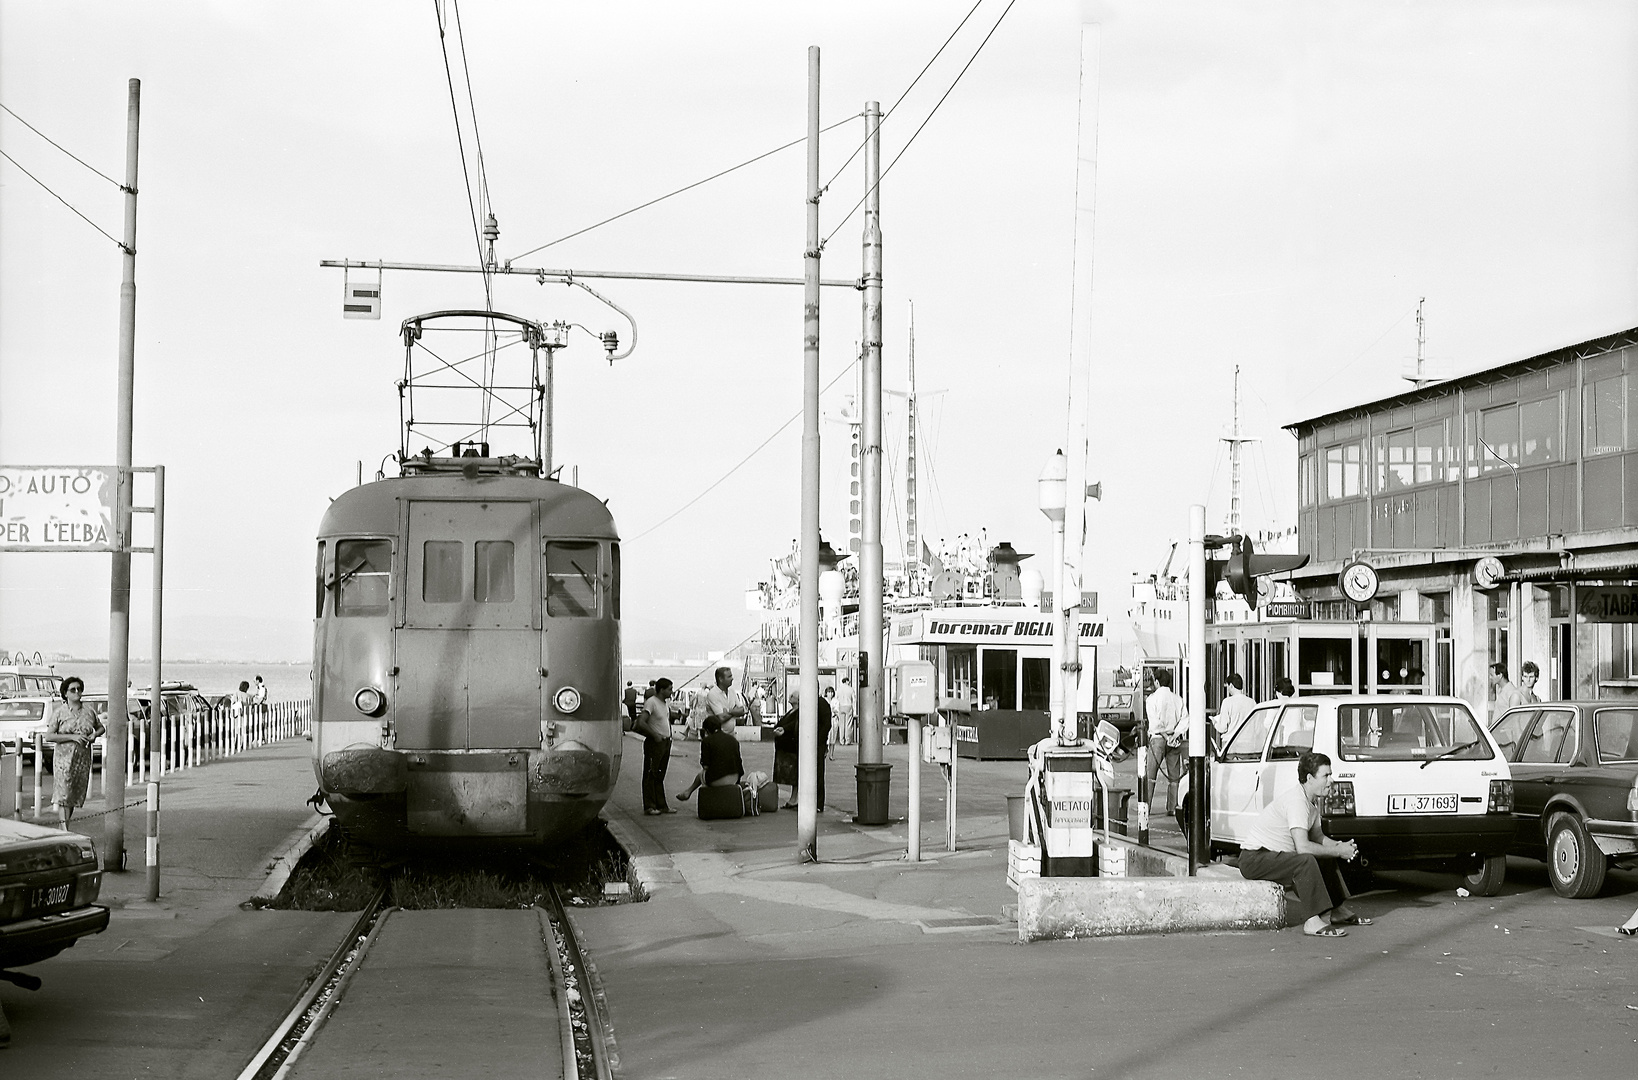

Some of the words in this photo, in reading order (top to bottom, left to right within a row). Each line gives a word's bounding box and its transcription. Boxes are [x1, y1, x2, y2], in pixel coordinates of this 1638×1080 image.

[27, 475, 91, 494] AUTO
[44, 523, 108, 543] L'ELBA
[1053, 801, 1090, 811] VIETATO
[1391, 797, 1407, 810] LI
[1416, 796, 1456, 810] 371693
